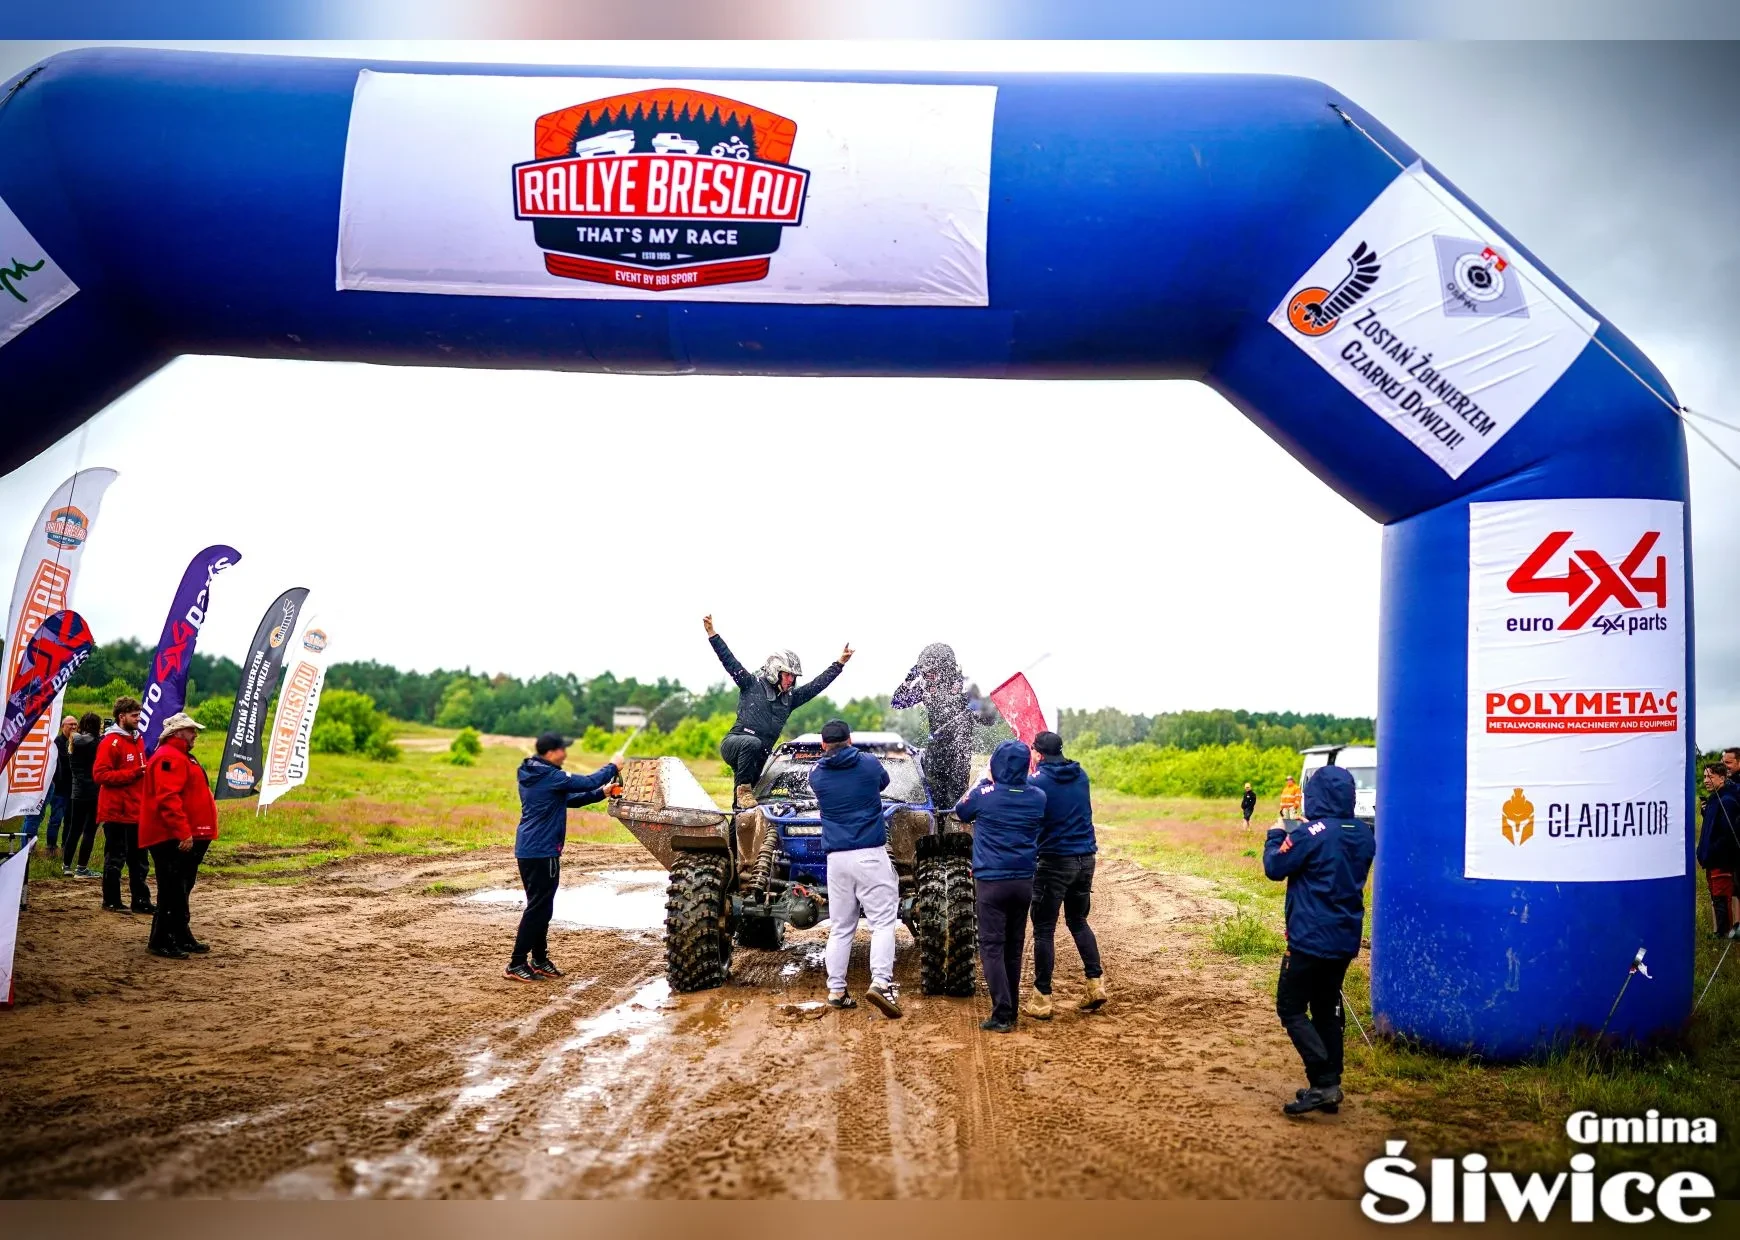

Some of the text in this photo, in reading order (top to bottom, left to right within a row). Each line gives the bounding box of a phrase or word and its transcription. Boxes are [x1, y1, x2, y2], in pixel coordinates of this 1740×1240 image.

[523, 159, 797, 216] RALLYE BRESLAU
[648, 228, 678, 244] MY
[686, 229, 738, 245] RACE
[615, 270, 698, 285] EVENT BY RBI SPORT
[1353, 308, 1496, 436] ZOSTAŃ ŻOŁNIERZEM
[1341, 340, 1465, 450] CZARNEJ DYWIZJI!
[1506, 617, 1553, 631] euro
[1629, 613, 1667, 635] parts
[138, 682, 161, 733] uro
[1489, 719, 1675, 729] METALWORKING MACHINERY AND EQUIPMENT
[1548, 800, 1668, 839] GLADIATOR
